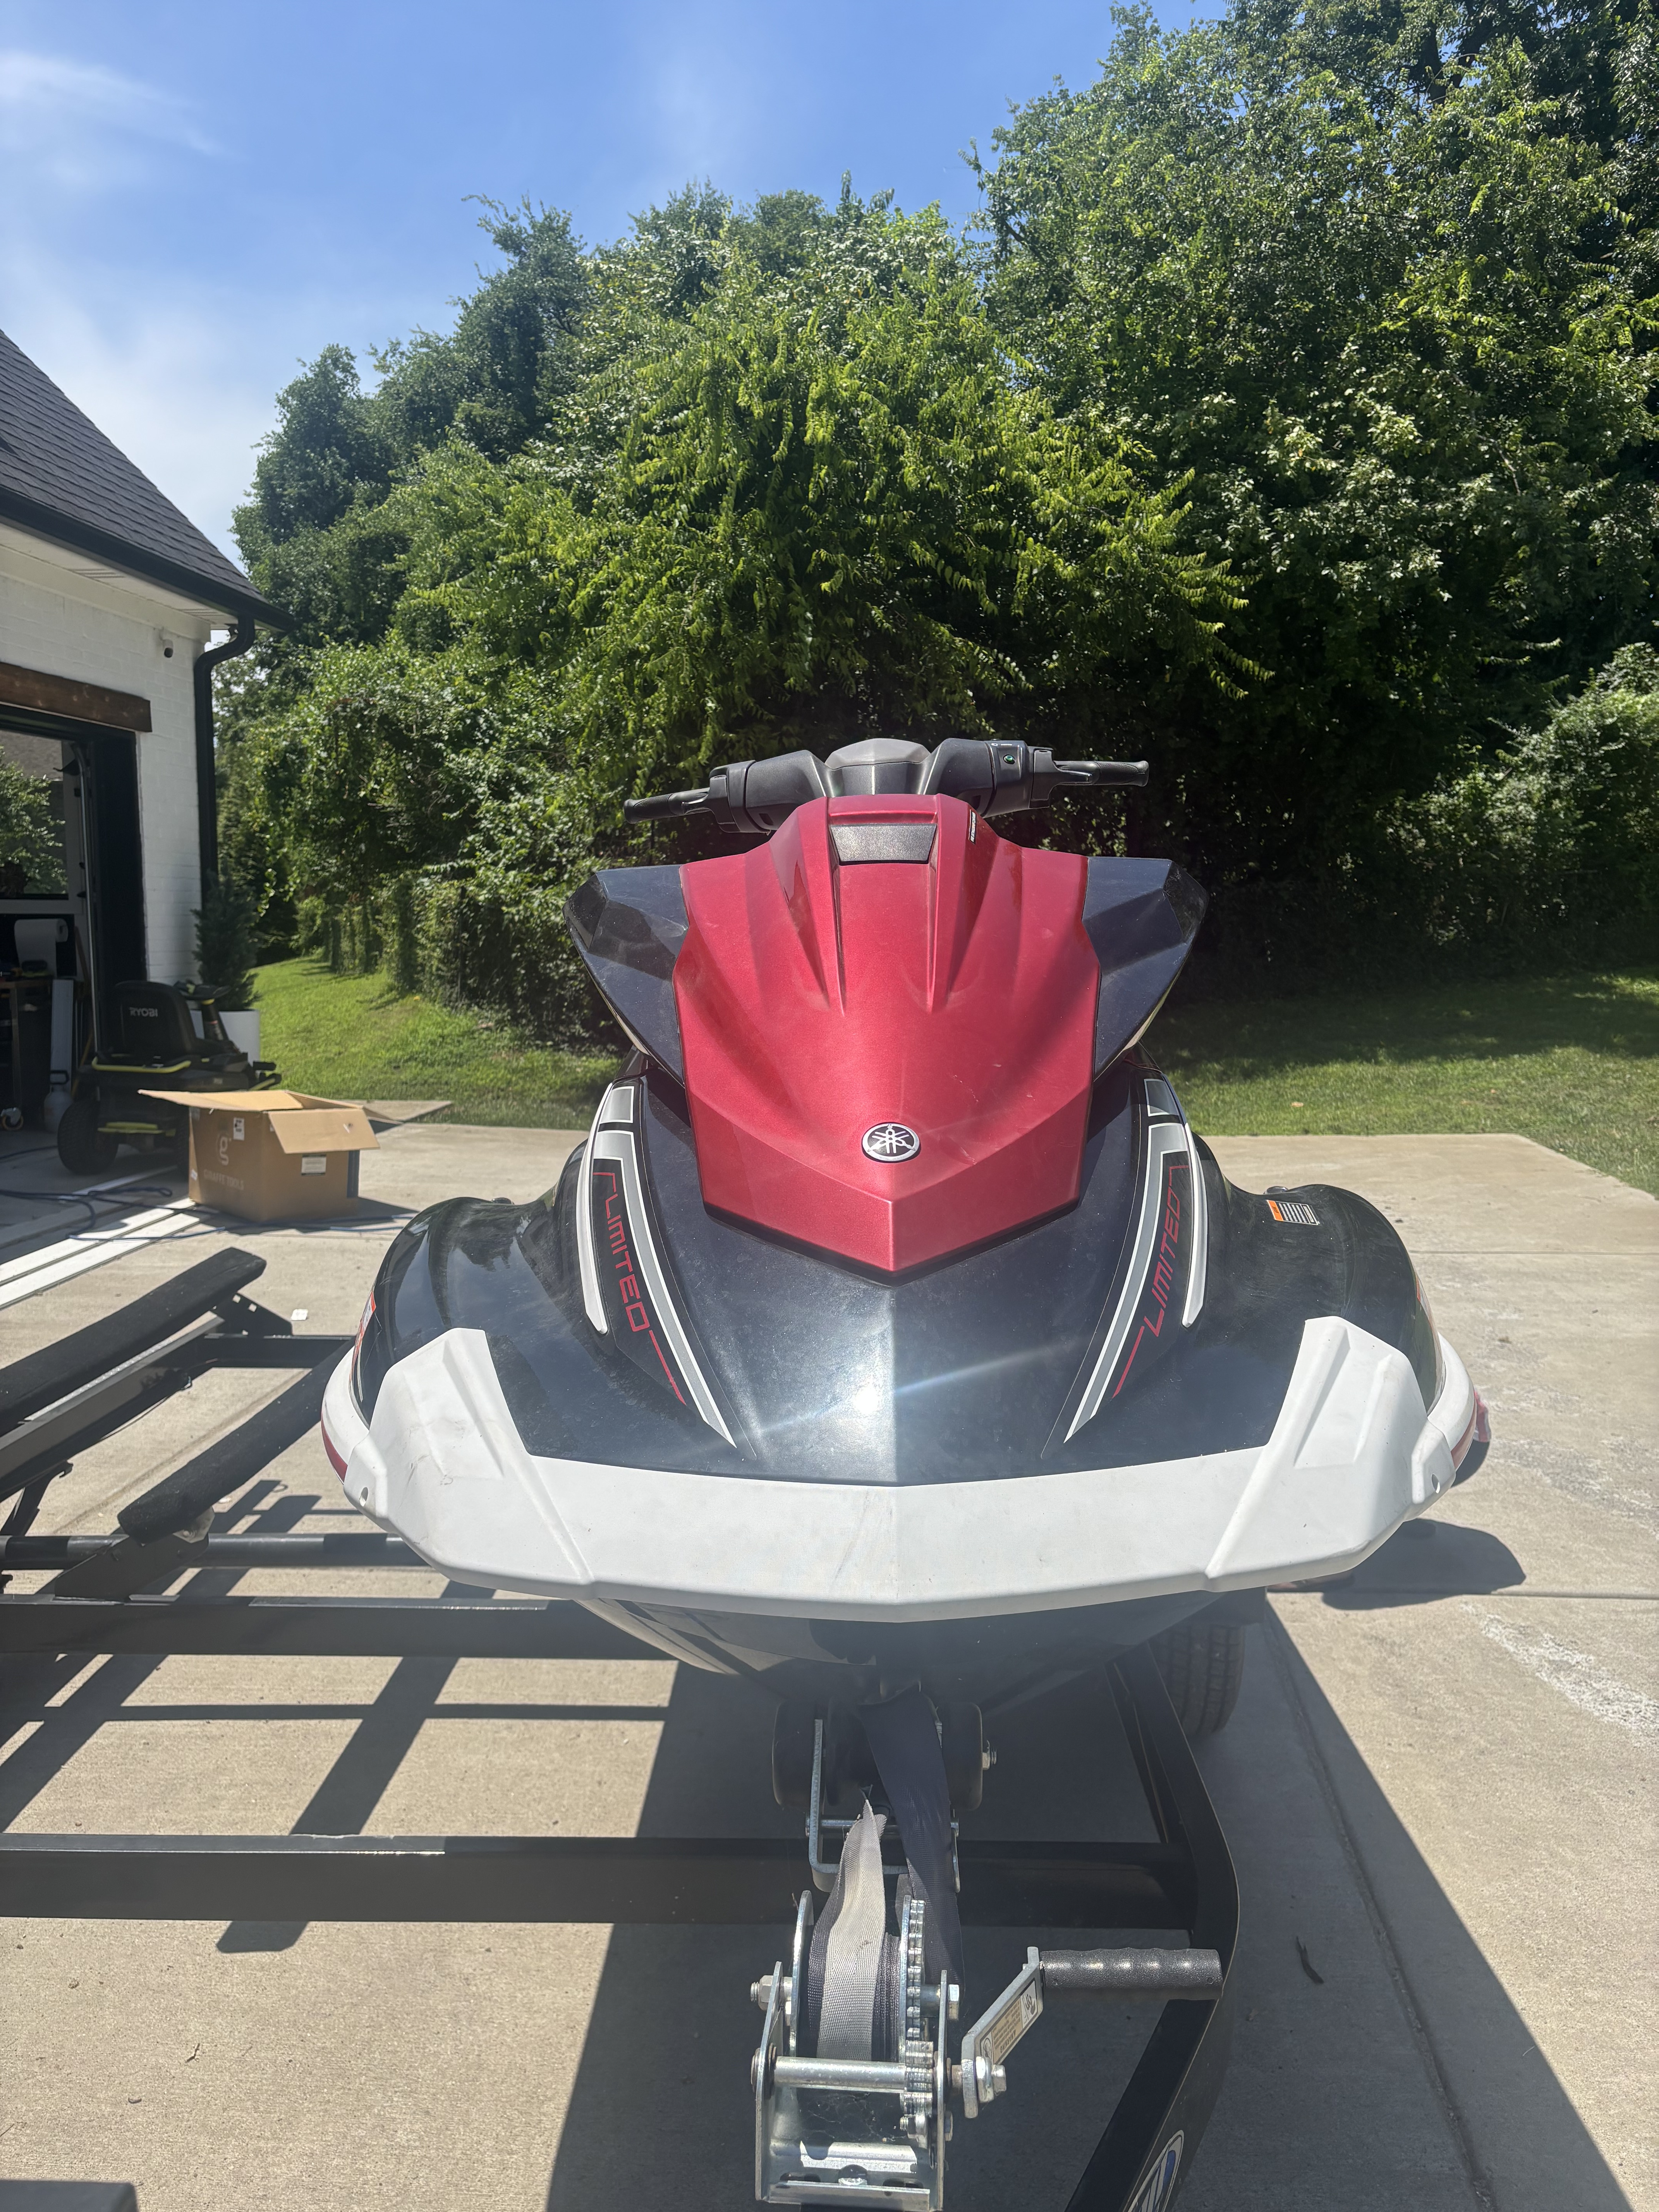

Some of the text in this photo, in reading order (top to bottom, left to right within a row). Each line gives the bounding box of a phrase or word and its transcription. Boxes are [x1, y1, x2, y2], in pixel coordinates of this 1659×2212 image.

[129, 1007, 158, 1017] RYOBI
[605, 1194, 650, 1332] LIMITED
[1144, 1186, 1180, 1337] LIMITED
